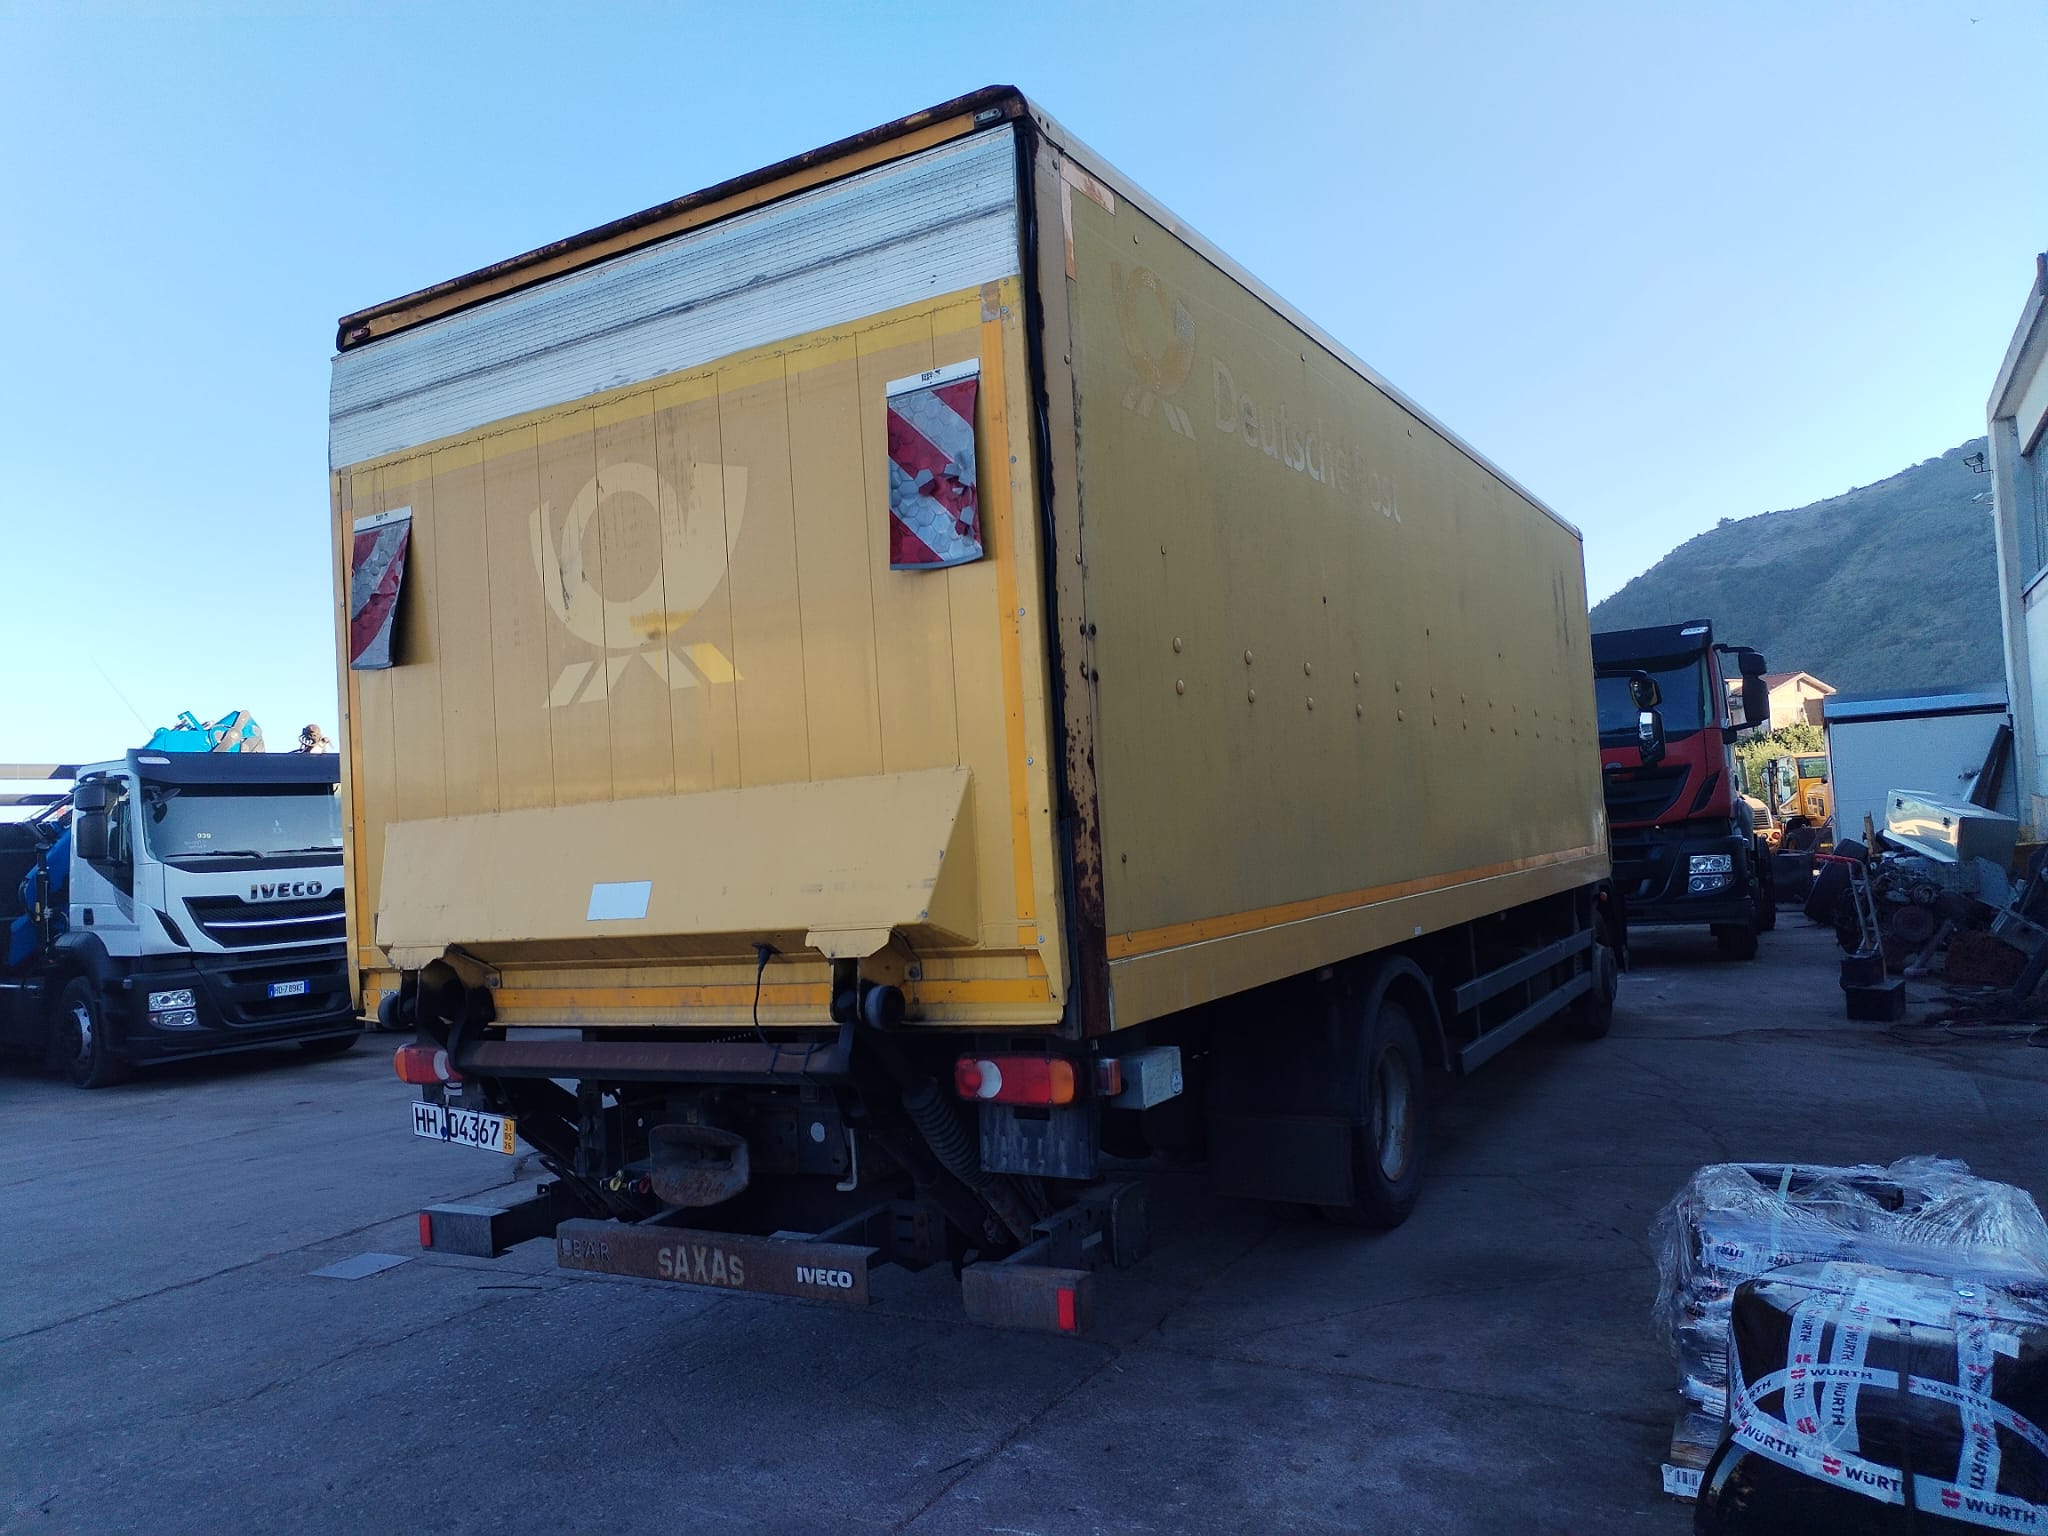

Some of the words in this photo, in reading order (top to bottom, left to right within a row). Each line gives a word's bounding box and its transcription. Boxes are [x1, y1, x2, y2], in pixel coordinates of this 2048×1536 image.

[250, 880, 323, 900] IVECO
[414, 1106, 438, 1135] HH
[657, 1245, 745, 1286] SAXAS
[797, 1265, 853, 1288] IVECO
[1845, 1466, 1902, 1493] WÜRT
